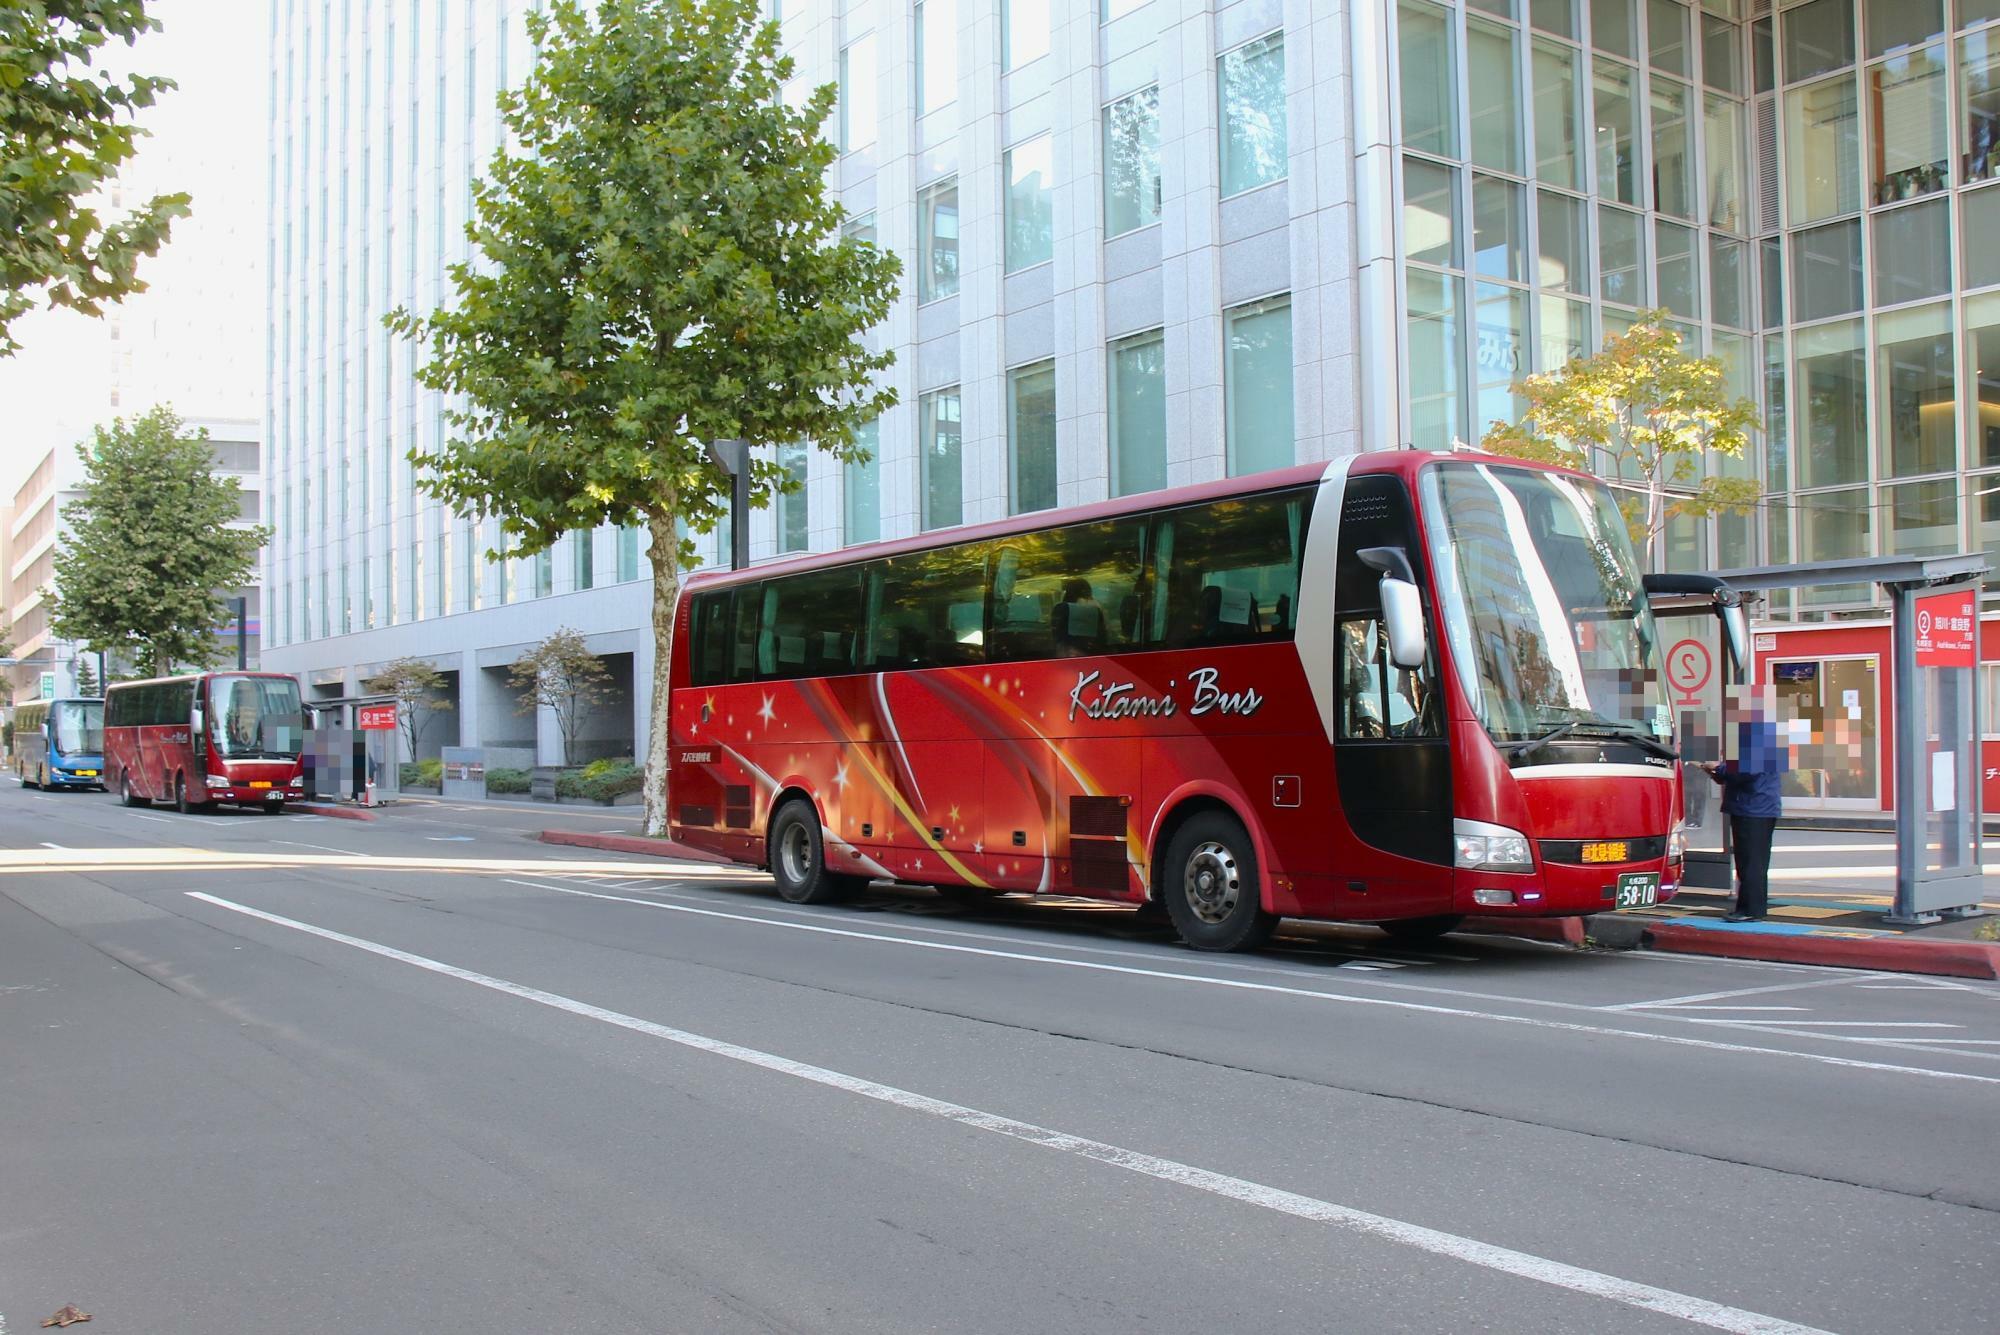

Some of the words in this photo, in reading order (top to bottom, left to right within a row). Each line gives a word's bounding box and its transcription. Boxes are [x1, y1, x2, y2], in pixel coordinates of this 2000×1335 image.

[1921, 616, 1927, 629] 2
[1068, 670, 1177, 721] Kitami
[1187, 666, 1263, 716] Bus
[1645, 757, 1668, 765] FUSO
[1985, 767, 2000, 780] チ
[1622, 885, 1655, 906] 58-10
